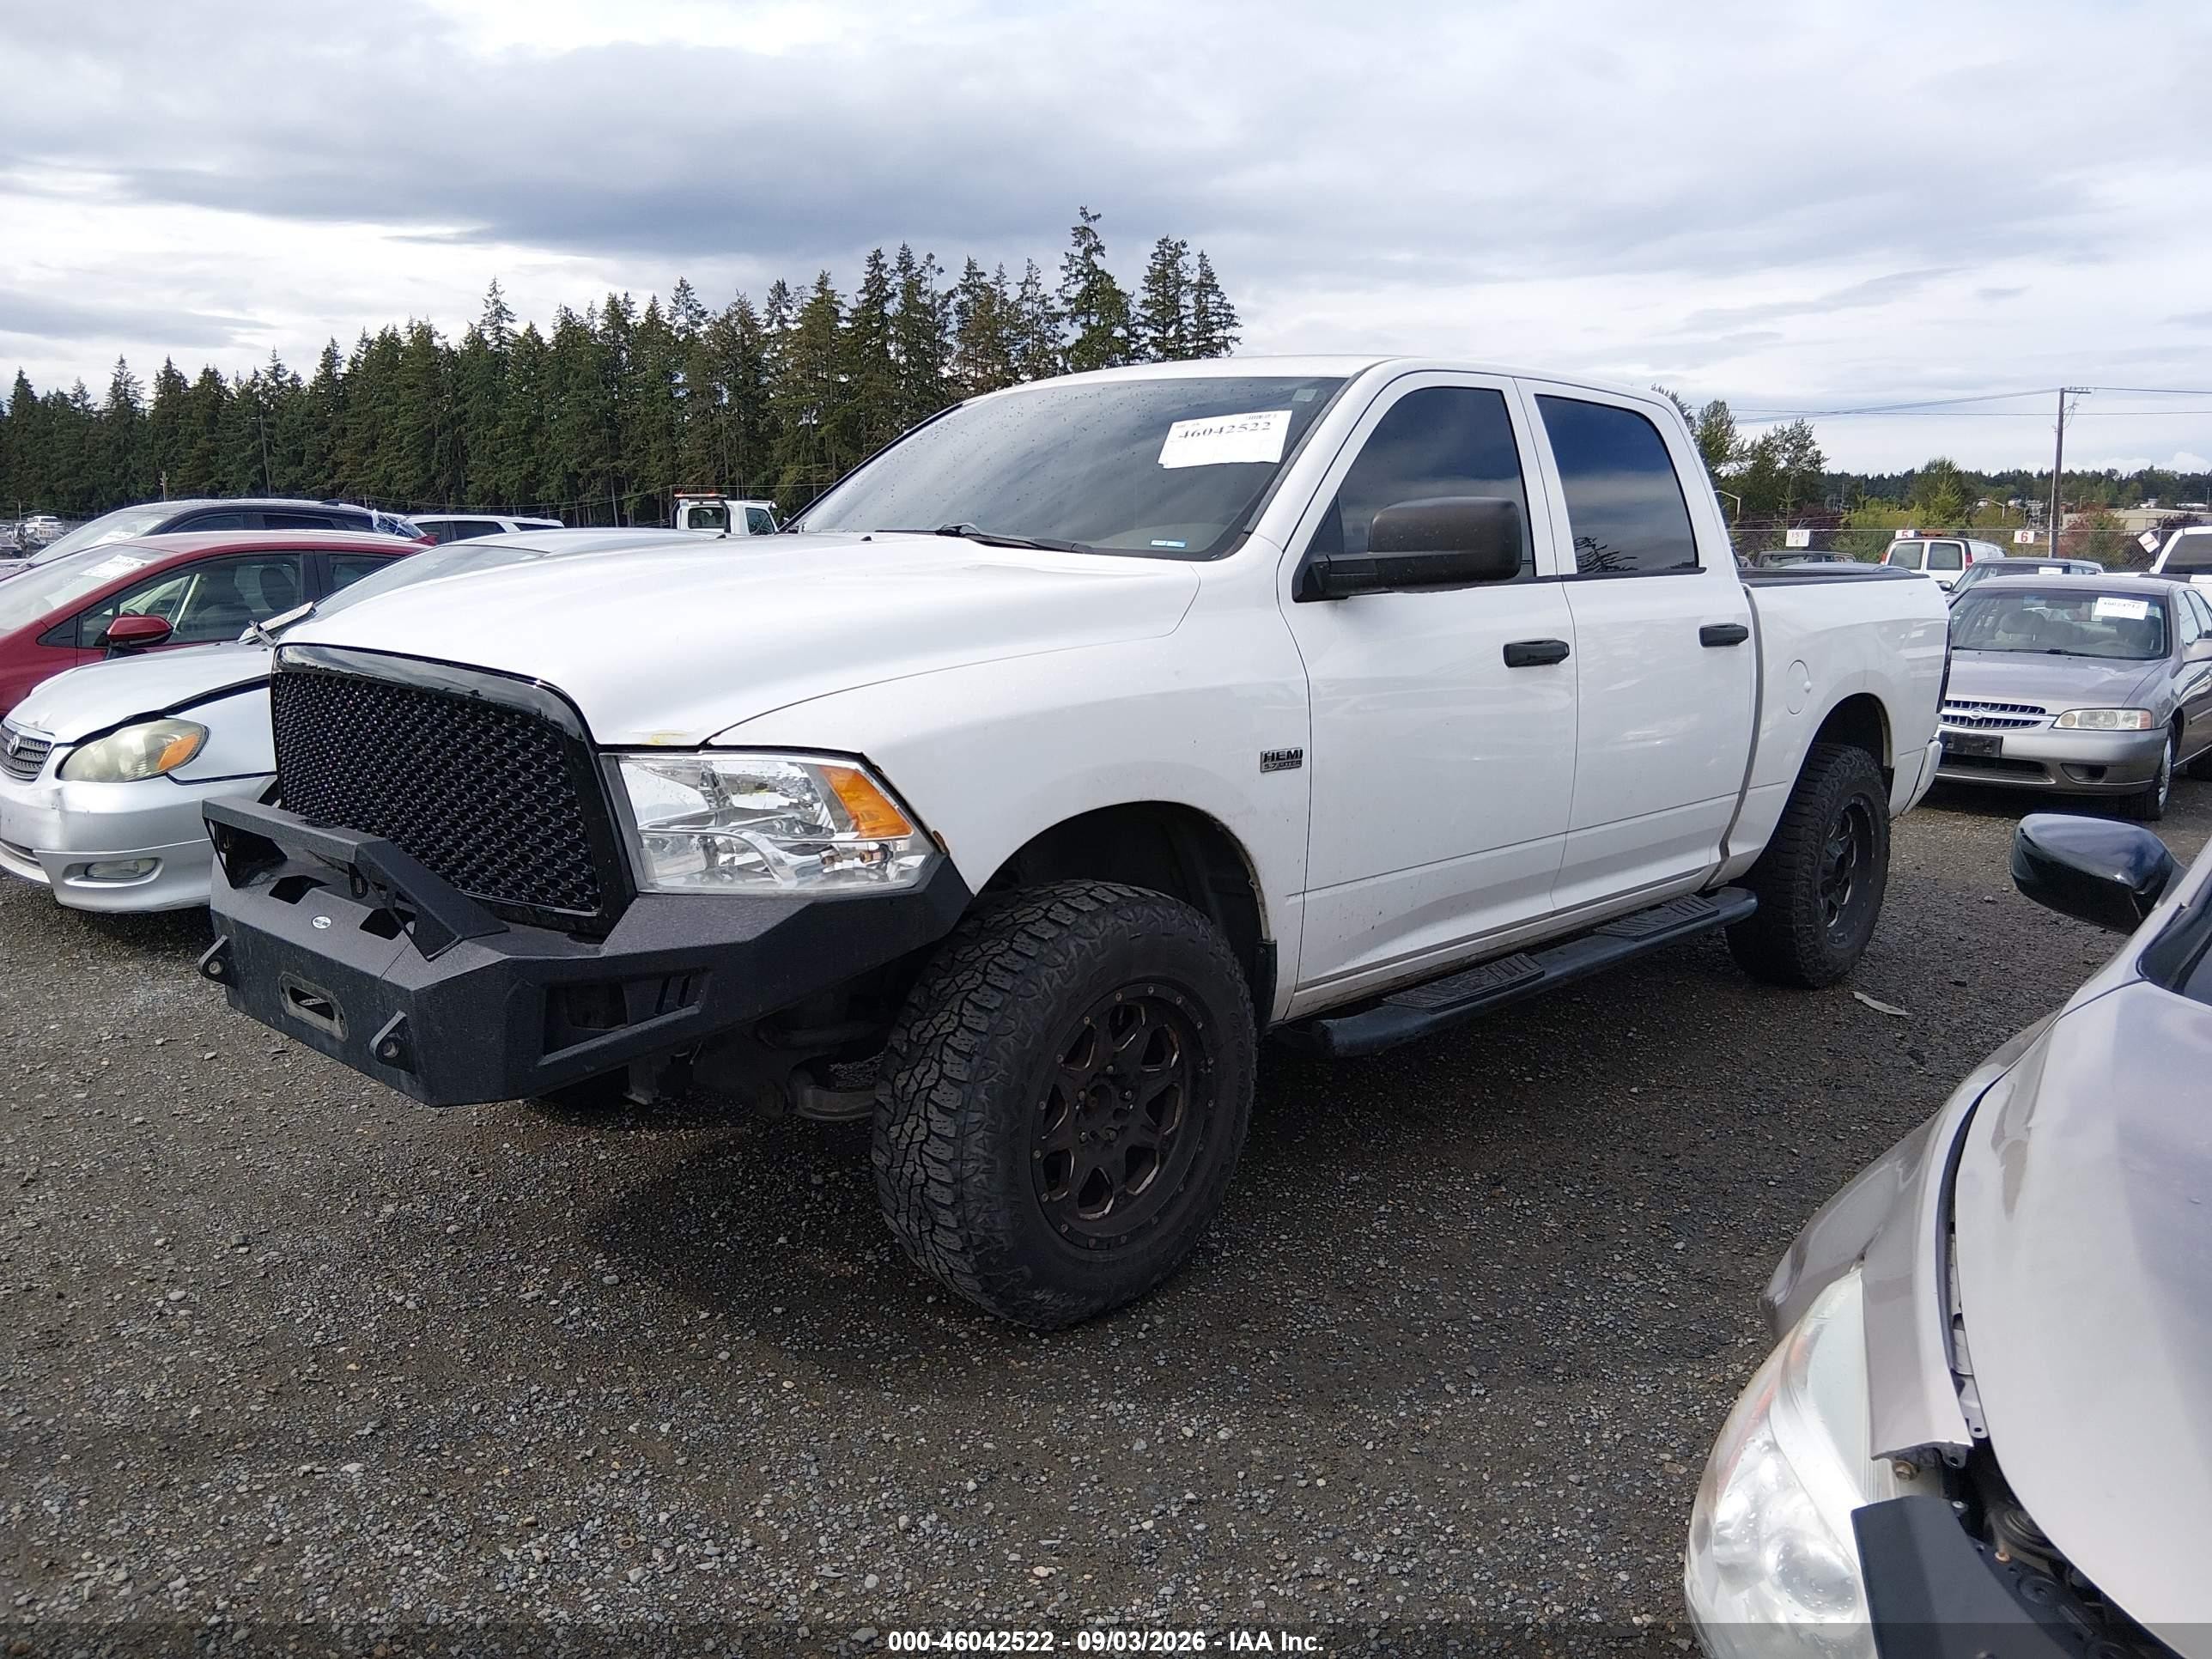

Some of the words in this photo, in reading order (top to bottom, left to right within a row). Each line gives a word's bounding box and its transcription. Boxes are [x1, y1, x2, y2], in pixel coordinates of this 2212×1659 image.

[1178, 422, 1271, 439] 46042522
[2021, 532, 2028, 543] 6
[1263, 750, 1304, 763] HEMI
